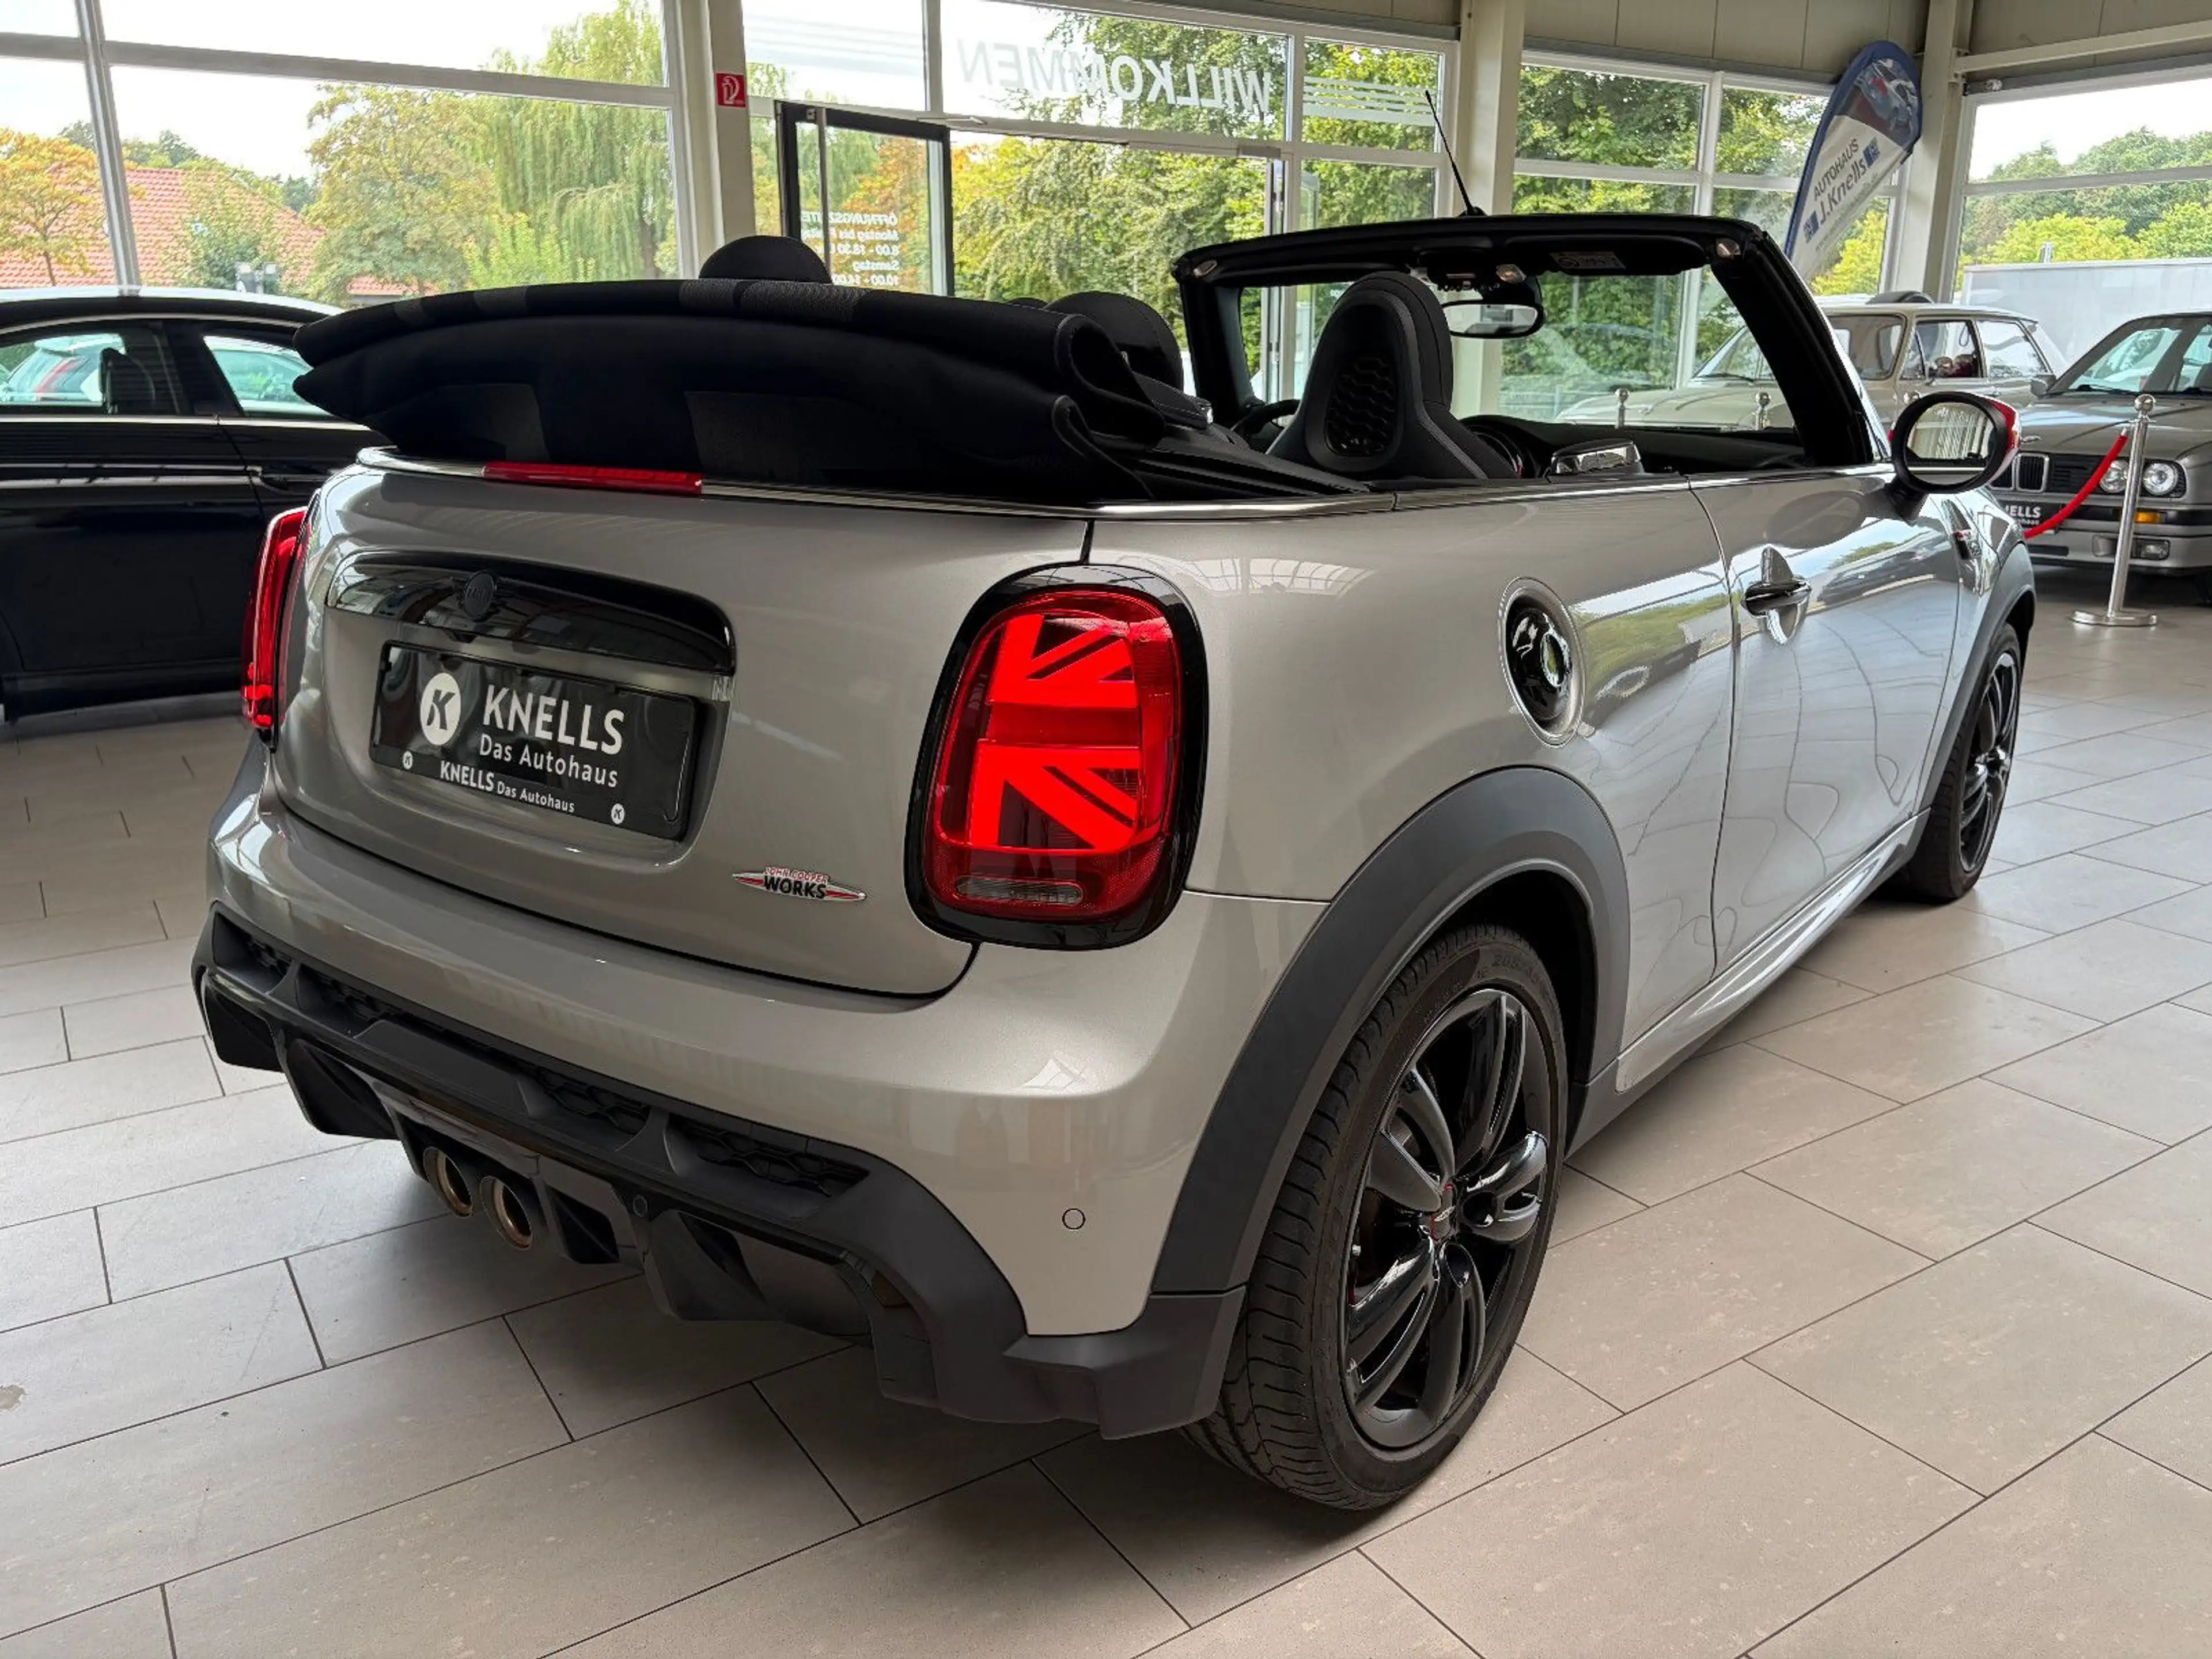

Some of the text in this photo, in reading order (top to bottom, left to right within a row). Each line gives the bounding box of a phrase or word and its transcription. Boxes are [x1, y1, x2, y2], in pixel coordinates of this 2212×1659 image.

[1815, 138, 1858, 201] AUTOHAUS
[1820, 158, 1867, 224] J.Knells
[483, 684, 625, 755] KNELLS
[440, 760, 575, 813] KNELLS Das Autohaus
[479, 733, 618, 789] Das Autohaus
[763, 875, 827, 899] WORKS
[791, 870, 828, 885] COOPER
